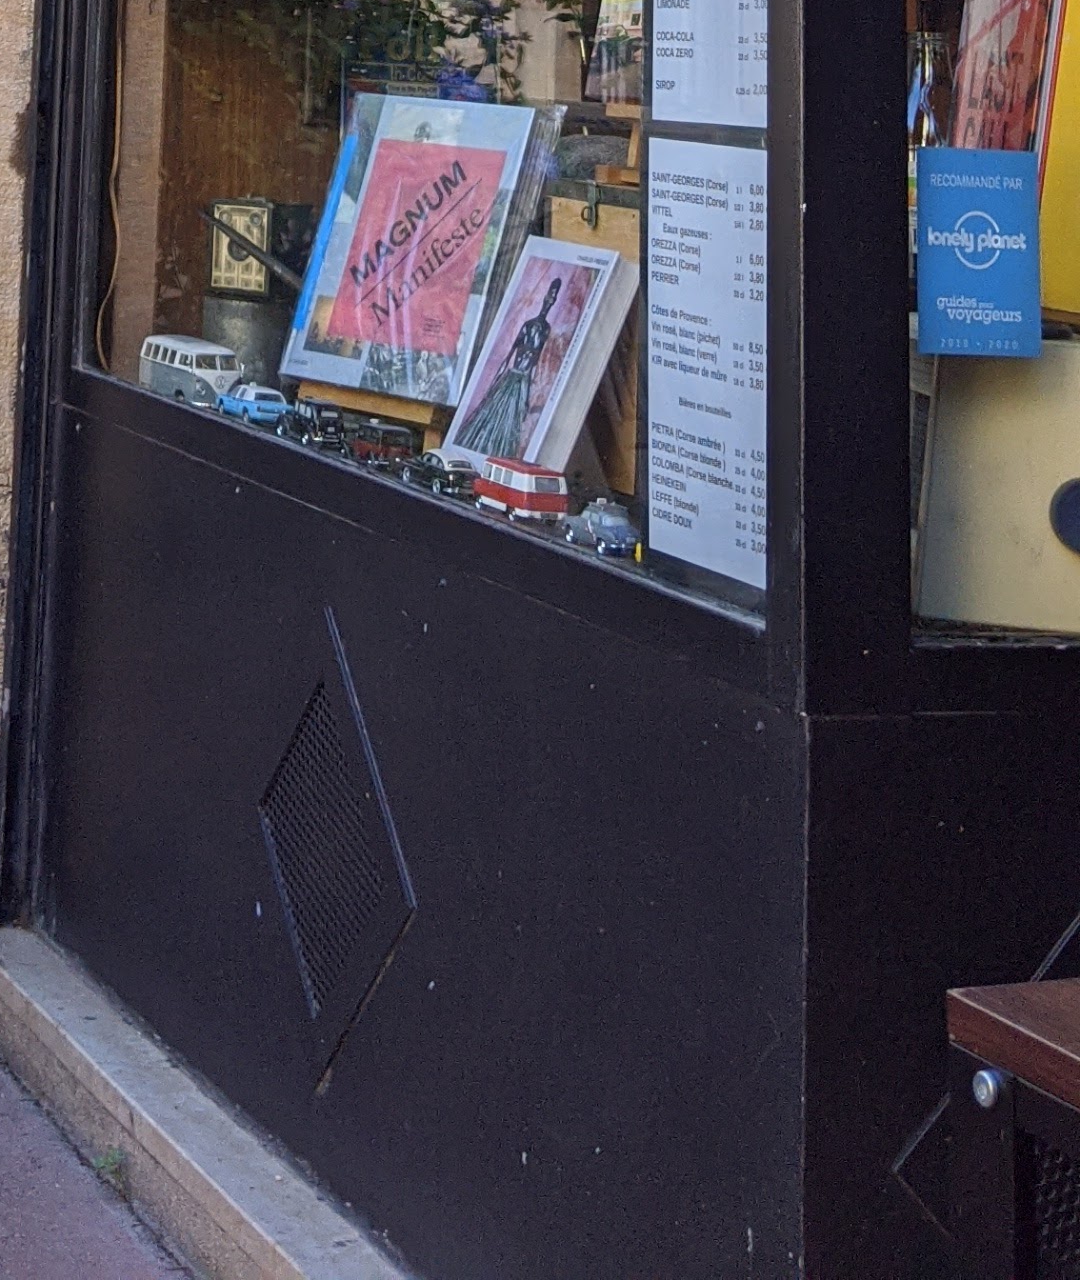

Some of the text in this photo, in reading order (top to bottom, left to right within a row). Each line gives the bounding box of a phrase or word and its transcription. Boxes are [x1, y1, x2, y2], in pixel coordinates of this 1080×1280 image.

[656, 0, 690, 9] LIMONADE
[656, 31, 694, 42] COCA-COLA
[656, 48, 674, 58] COCA
[675, 48, 694, 58] ZERO
[656, 80, 675, 90] SIROP
[652, 171, 704, 189] SAINT-GEORGES
[706, 178, 728, 194] (Corse)
[930, 173, 1023, 190] RECOMMANDÉ PAR
[652, 188, 704, 205] SAINT-GEORGES
[706, 195, 728, 211] (Corse)
[652, 205, 673, 217] VITTEL
[349, 160, 467, 287] MAGNUM
[663, 222, 708, 240] Eaux gazeuses
[651, 238, 677, 251] OREZZA
[678, 242, 701, 257] (Corse)
[927, 226, 1027, 253] lonely planet
[370, 208, 485, 327] Manifeste
[651, 254, 677, 268] OREZZA
[678, 258, 701, 274] (Corse)
[651, 270, 679, 285] PERRIER
[936, 296, 978, 310] guides
[670, 308, 677, 319] de
[679, 309, 708, 326] Provence
[947, 306, 1023, 324] voyageurs
[651, 321, 660, 332] Vin
[679, 326, 695, 340] blanc
[651, 337, 660, 349] Vin
[679, 344, 695, 358] blanc
[652, 355, 662, 365] KIR
[663, 359, 677, 370] avec
[679, 360, 700, 375] liqueur
[701, 366, 709, 378] de
[697, 402, 703, 411] en
[652, 421, 674, 437] PIETRA
[652, 455, 684, 475] COLOMBA
[652, 490, 672, 506] LEFFE
[652, 507, 672, 523] CIDRE
[673, 514, 692, 529] DOUX
